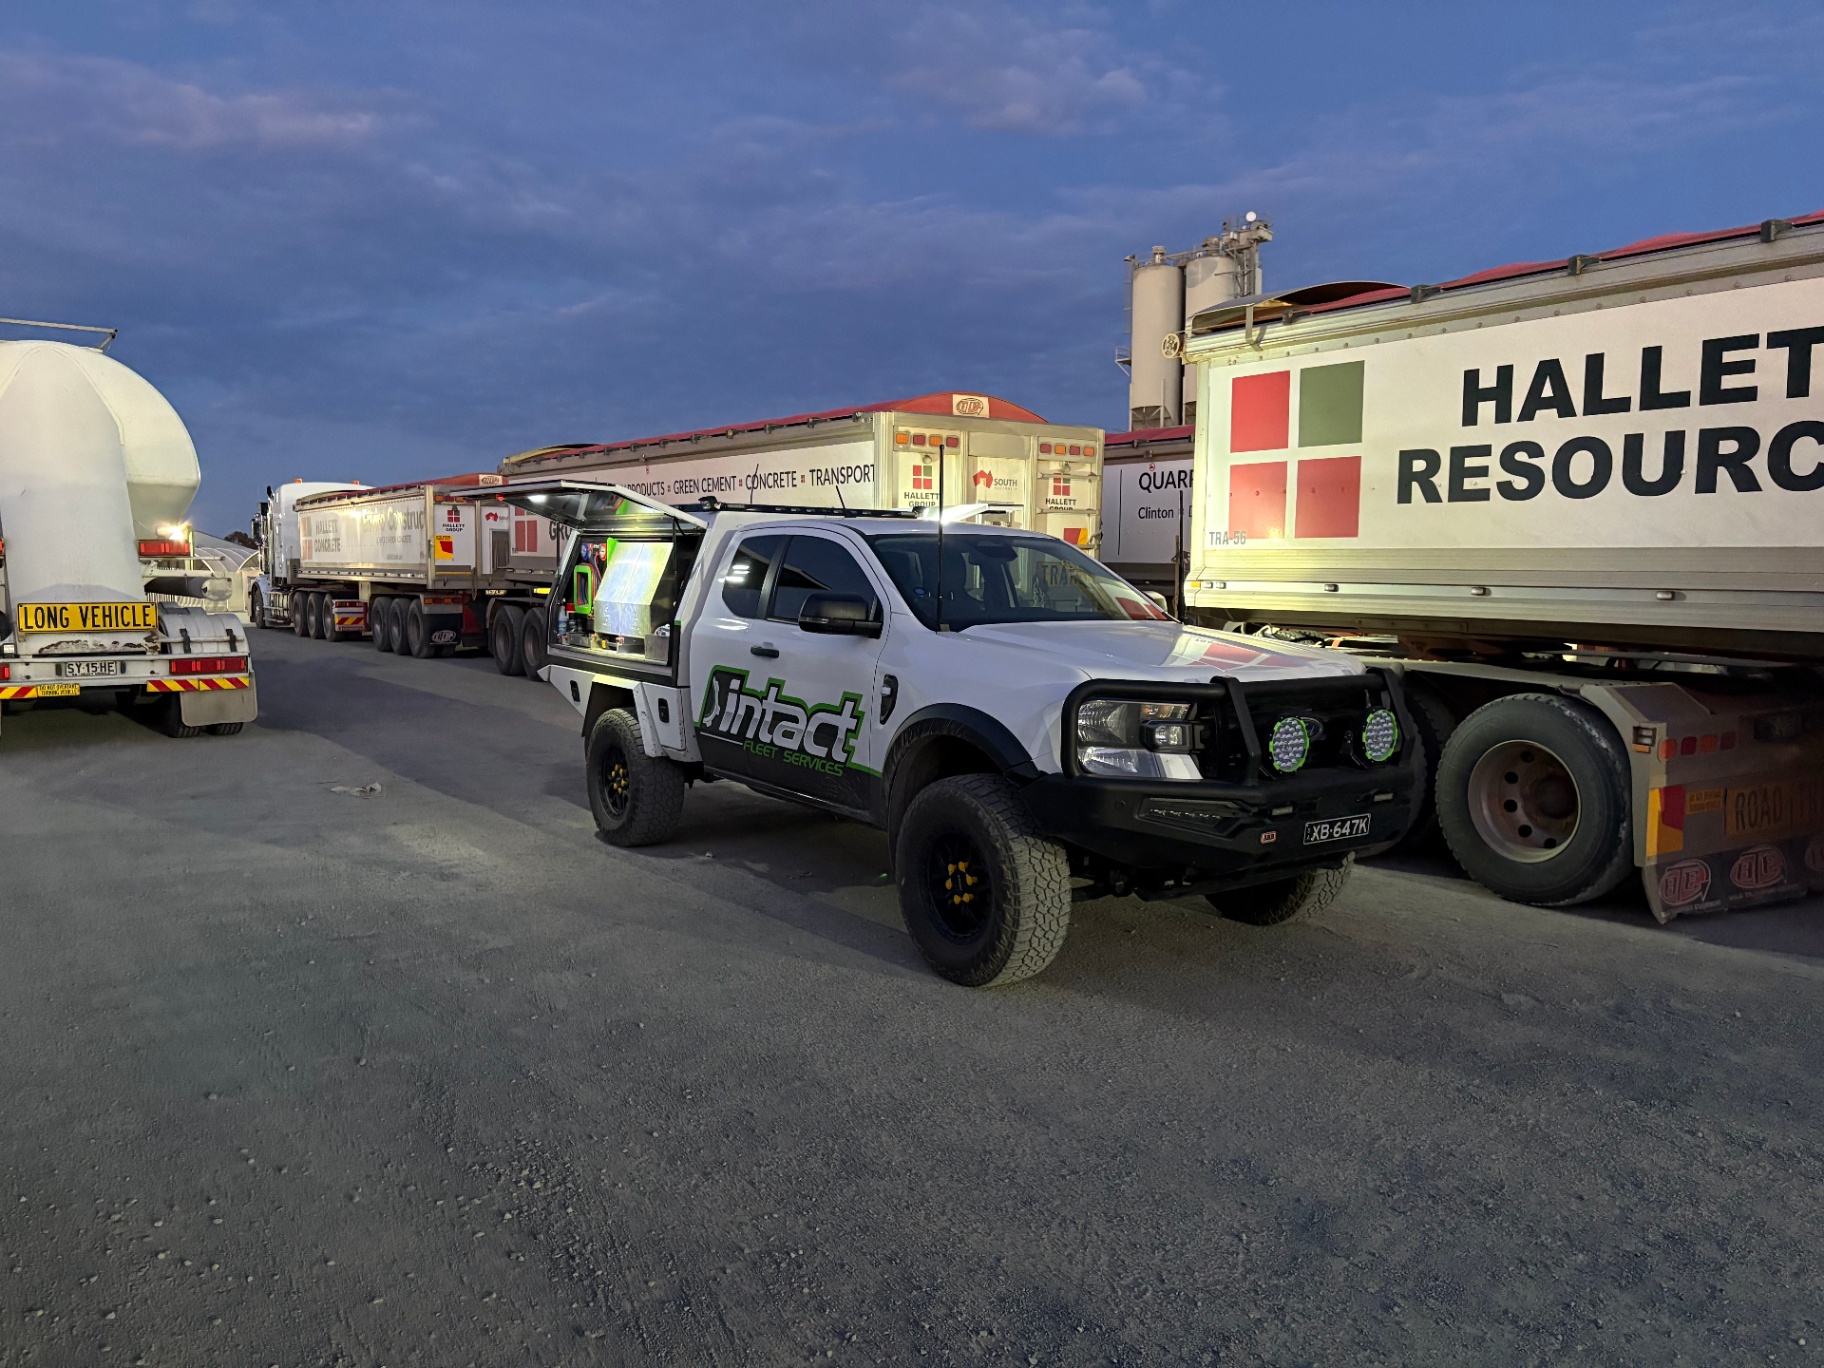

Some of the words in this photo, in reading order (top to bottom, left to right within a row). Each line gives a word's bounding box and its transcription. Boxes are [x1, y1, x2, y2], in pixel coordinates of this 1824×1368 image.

[1461, 327, 1824, 427] HALLET
[1397, 420, 1824, 504] RESOURC
[673, 479, 699, 494] GREEN
[701, 475, 736, 493] CEMENT
[745, 471, 797, 489] CONCRETE
[809, 463, 874, 486] TRANSPORT
[994, 478, 1017, 486] SOUTH
[903, 491, 940, 500] HALLETT
[1045, 498, 1077, 506] HALLETT
[1138, 506, 1174, 519] Clinton
[1208, 530, 1247, 546] TRA-56
[24, 605, 69, 629] LONG
[79, 604, 151, 628] VEHICLE
[743, 740, 778, 758] FLEET
[783, 750, 844, 777] SERVICES
[1735, 785, 1783, 831] ROAD
